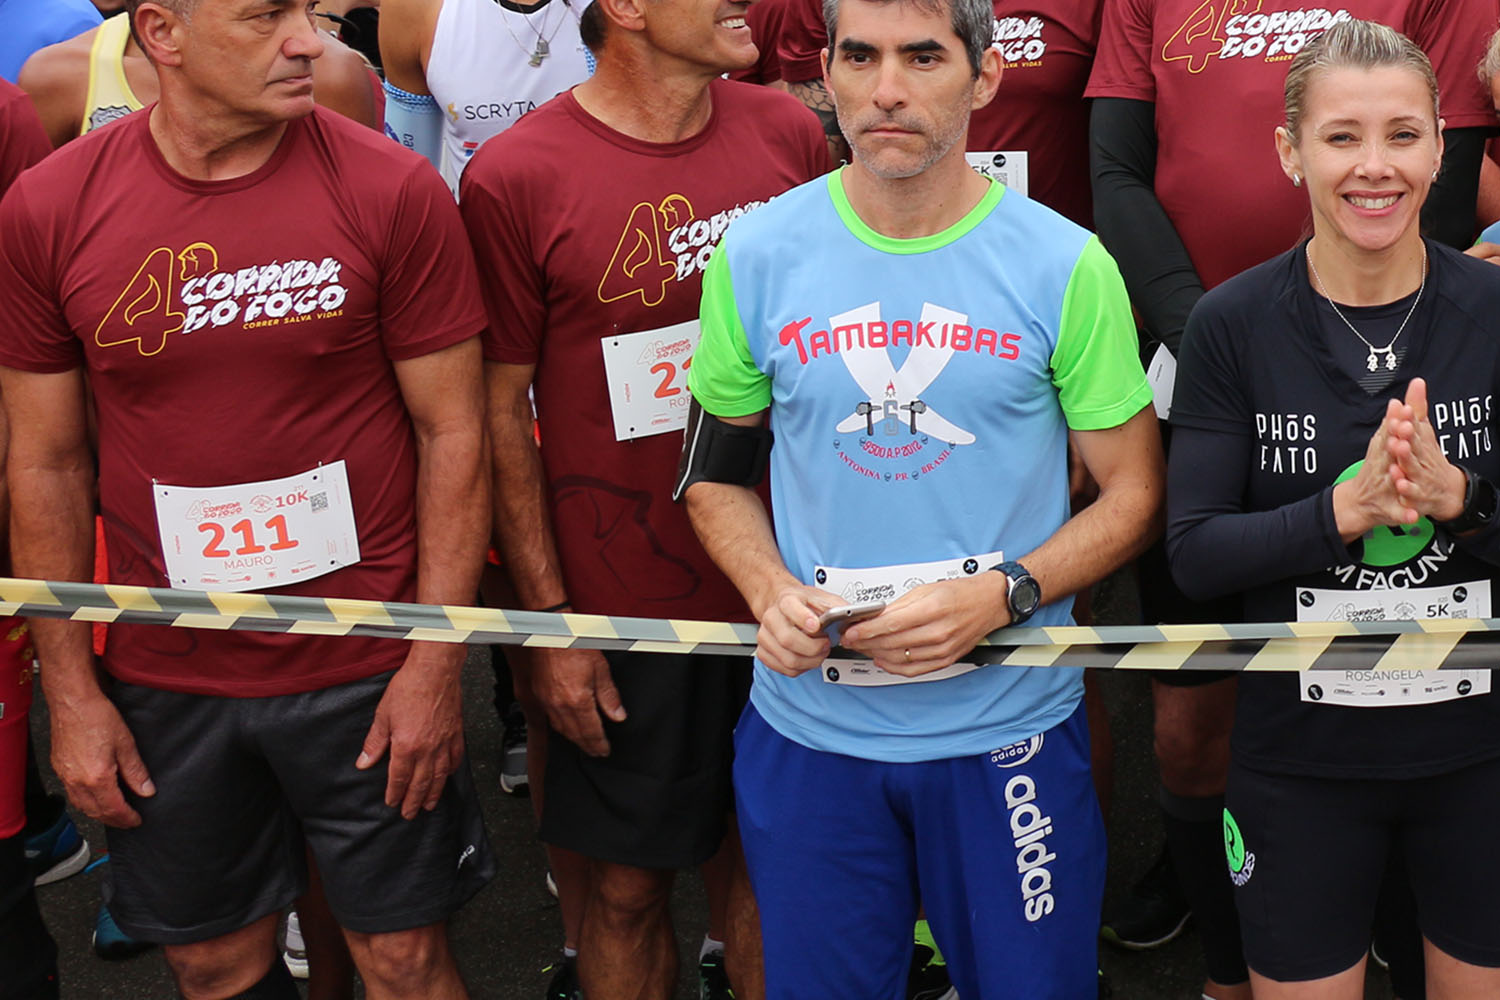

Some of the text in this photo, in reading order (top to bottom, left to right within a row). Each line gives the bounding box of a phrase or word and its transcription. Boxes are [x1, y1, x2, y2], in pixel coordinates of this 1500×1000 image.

[181, 257, 341, 305] CORRIDA
[182, 284, 348, 334] DO FOGO
[243, 310, 343, 330] CORRER SALVA VIDAS
[837, 449, 951, 480] ANTONINA PR BRASIL
[1260, 445, 1318, 474] FATO
[276, 490, 309, 508] 10K
[198, 514, 299, 558] 211
[224, 555, 273, 570] MAURO
[1426, 604, 1449, 618] 5K
[1345, 669, 1424, 682] ROSANGELA
[991, 745, 1029, 763] adidas
[1004, 774, 1056, 922] adidas
